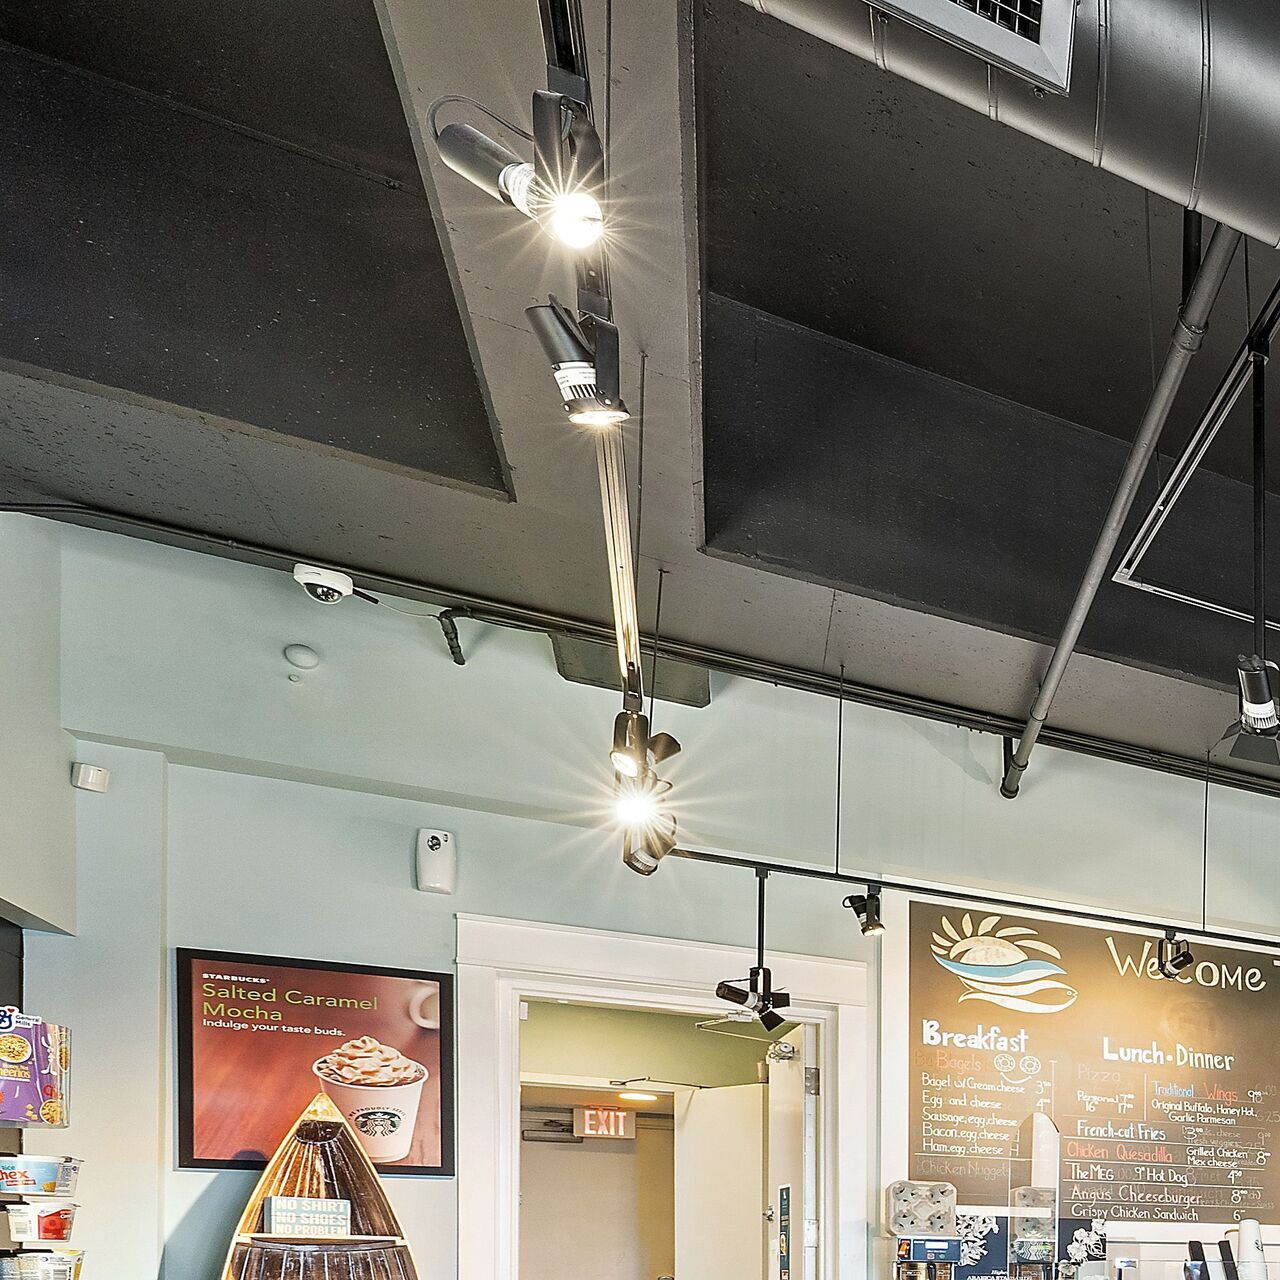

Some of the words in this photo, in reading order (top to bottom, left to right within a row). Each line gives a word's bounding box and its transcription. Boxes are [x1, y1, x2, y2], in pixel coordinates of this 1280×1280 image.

[202, 973, 267, 984] STARBUCKS
[202, 982, 277, 1002] Salted
[284, 990, 379, 1010] Caramel
[203, 1002, 283, 1021] Mocha
[203, 1018, 249, 1031] Indulge
[251, 1023, 279, 1032] your
[281, 1025, 312, 1034] taste
[314, 1026, 346, 1037] buds.
[921, 1019, 1029, 1053] Breakfast
[1102, 1036, 1156, 1065] Lunch
[1175, 1042, 1235, 1072] Dinner
[922, 1072, 950, 1090] Bagel
[922, 1090, 943, 1108] Egg
[949, 1093, 967, 1106] and
[970, 1094, 1002, 1109] cheese
[1077, 1090, 1119, 1104] Personal
[1152, 1080, 1194, 1097] Traditional
[1203, 1082, 1238, 1106] Wings
[1152, 1099, 1182, 1113] Original
[1216, 1103, 1241, 1117] Honey
[584, 1110, 627, 1136] EXIT
[1168, 1111, 1195, 1122] Garlic
[1197, 1113, 1236, 1125] Parmesan
[1077, 1120, 1134, 1139] French-cut
[1138, 1123, 1166, 1140] Fries
[1066, 1143, 1109, 1159] Chicken
[1116, 1144, 1173, 1162] Quesadilla
[1186, 1147, 1214, 1157] Grilled
[1217, 1147, 1248, 1159] Chicken
[1208, 1157, 1238, 1168] cheese
[0, 1170, 30, 1181] hex
[1065, 1162, 1089, 1180] The
[1089, 1165, 1114, 1181] MEG
[1146, 1168, 1165, 1181] Hot
[1169, 1170, 1188, 1187] Dog
[276, 1200, 297, 1211] NO
[302, 1201, 347, 1212] SHIRT
[1071, 1185, 1112, 1206] Angus
[1119, 1185, 1202, 1209] Cheeseburger
[276, 1212, 297, 1224] NO
[300, 1213, 346, 1225] SHOES
[1071, 1204, 1108, 1222] Crispy
[1111, 1206, 1150, 1219] Chicken
[1153, 1208, 1199, 1221] Sandwich
[276, 1224, 292, 1235] NO
[295, 1224, 346, 1236] PROBLEM
